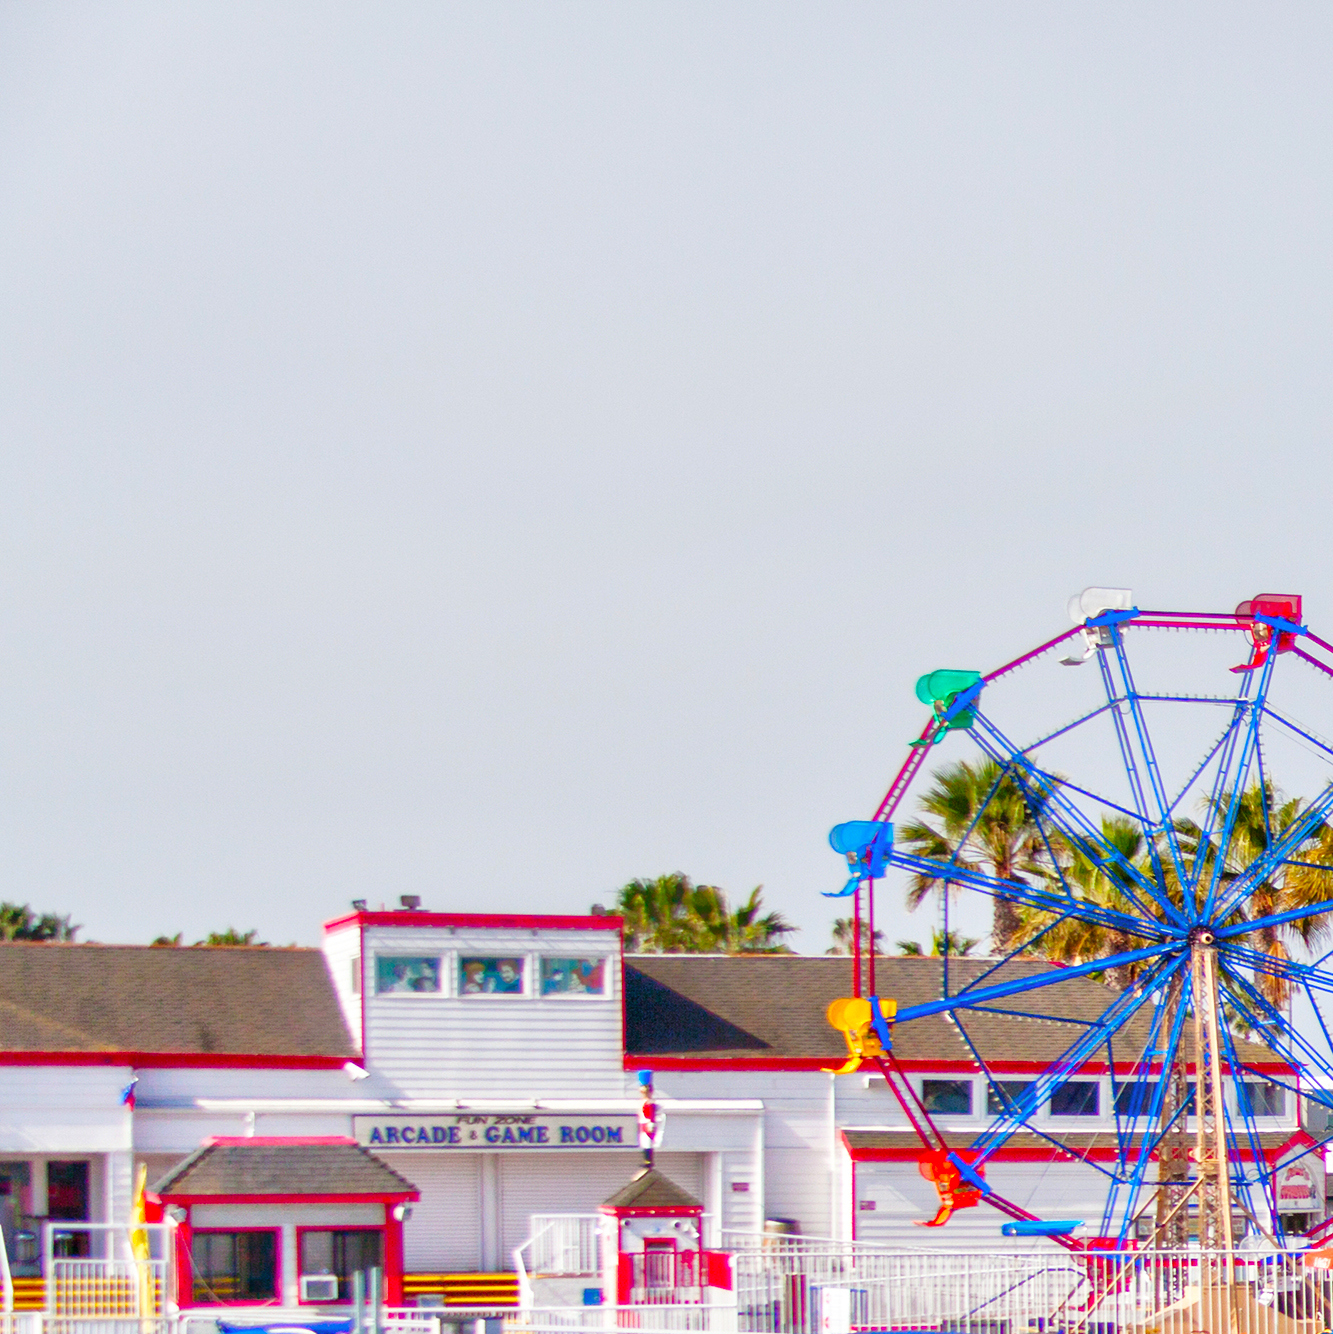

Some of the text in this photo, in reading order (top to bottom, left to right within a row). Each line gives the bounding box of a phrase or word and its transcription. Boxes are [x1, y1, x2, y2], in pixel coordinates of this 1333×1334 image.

[456, 1116, 537, 1125] FUN ZONE
[369, 1126, 624, 1144] ARCADE & GAME ROOM
